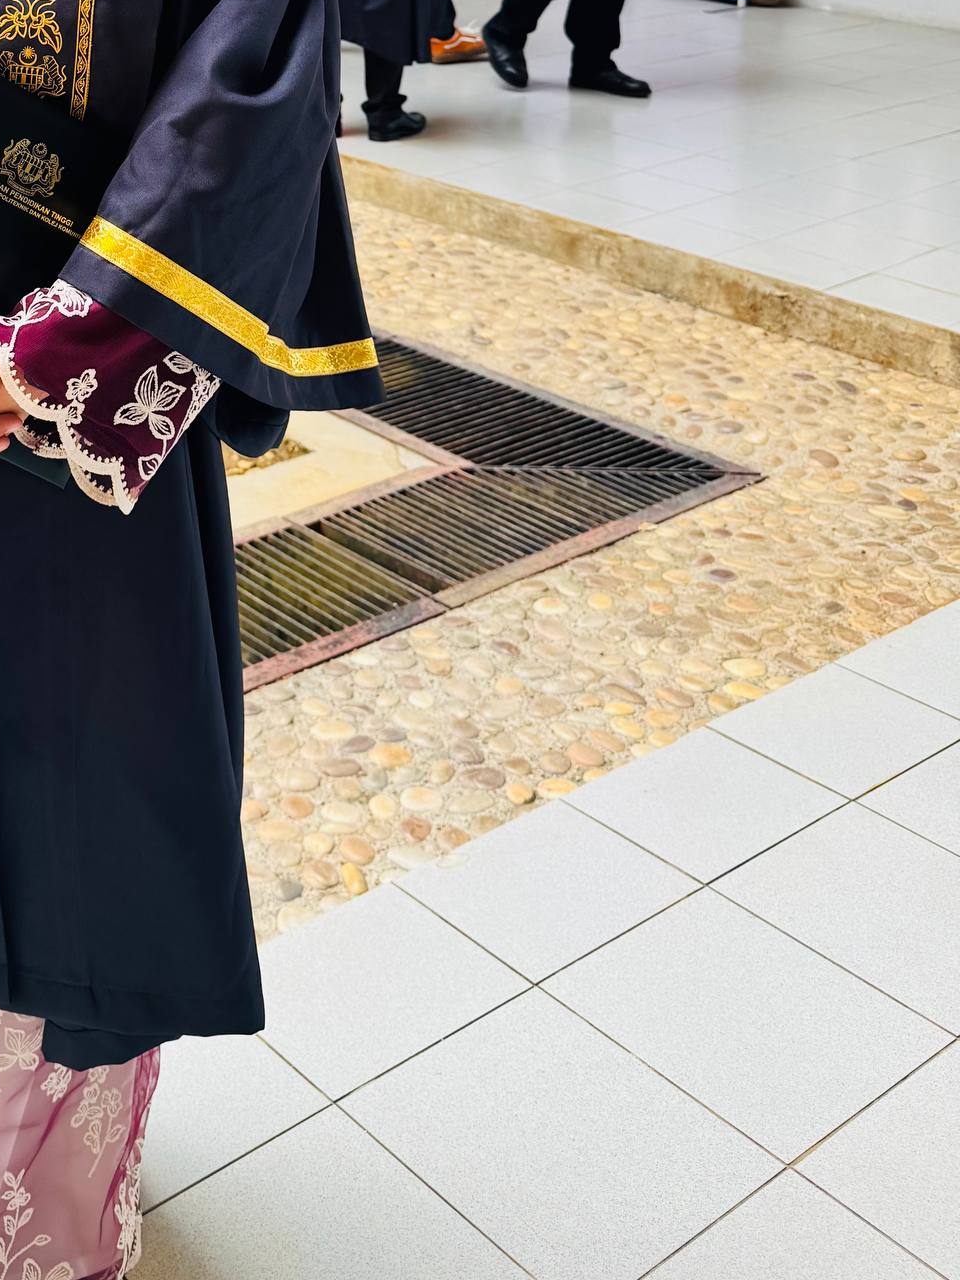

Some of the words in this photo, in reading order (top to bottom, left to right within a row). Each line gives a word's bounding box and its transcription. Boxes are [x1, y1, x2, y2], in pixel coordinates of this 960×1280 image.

[9, 189, 51, 215] PENDIDIKAN
[50, 210, 74, 228] TINGGI
[28, 208, 42, 220] DAN
[40, 214, 59, 228] KOLEJ
